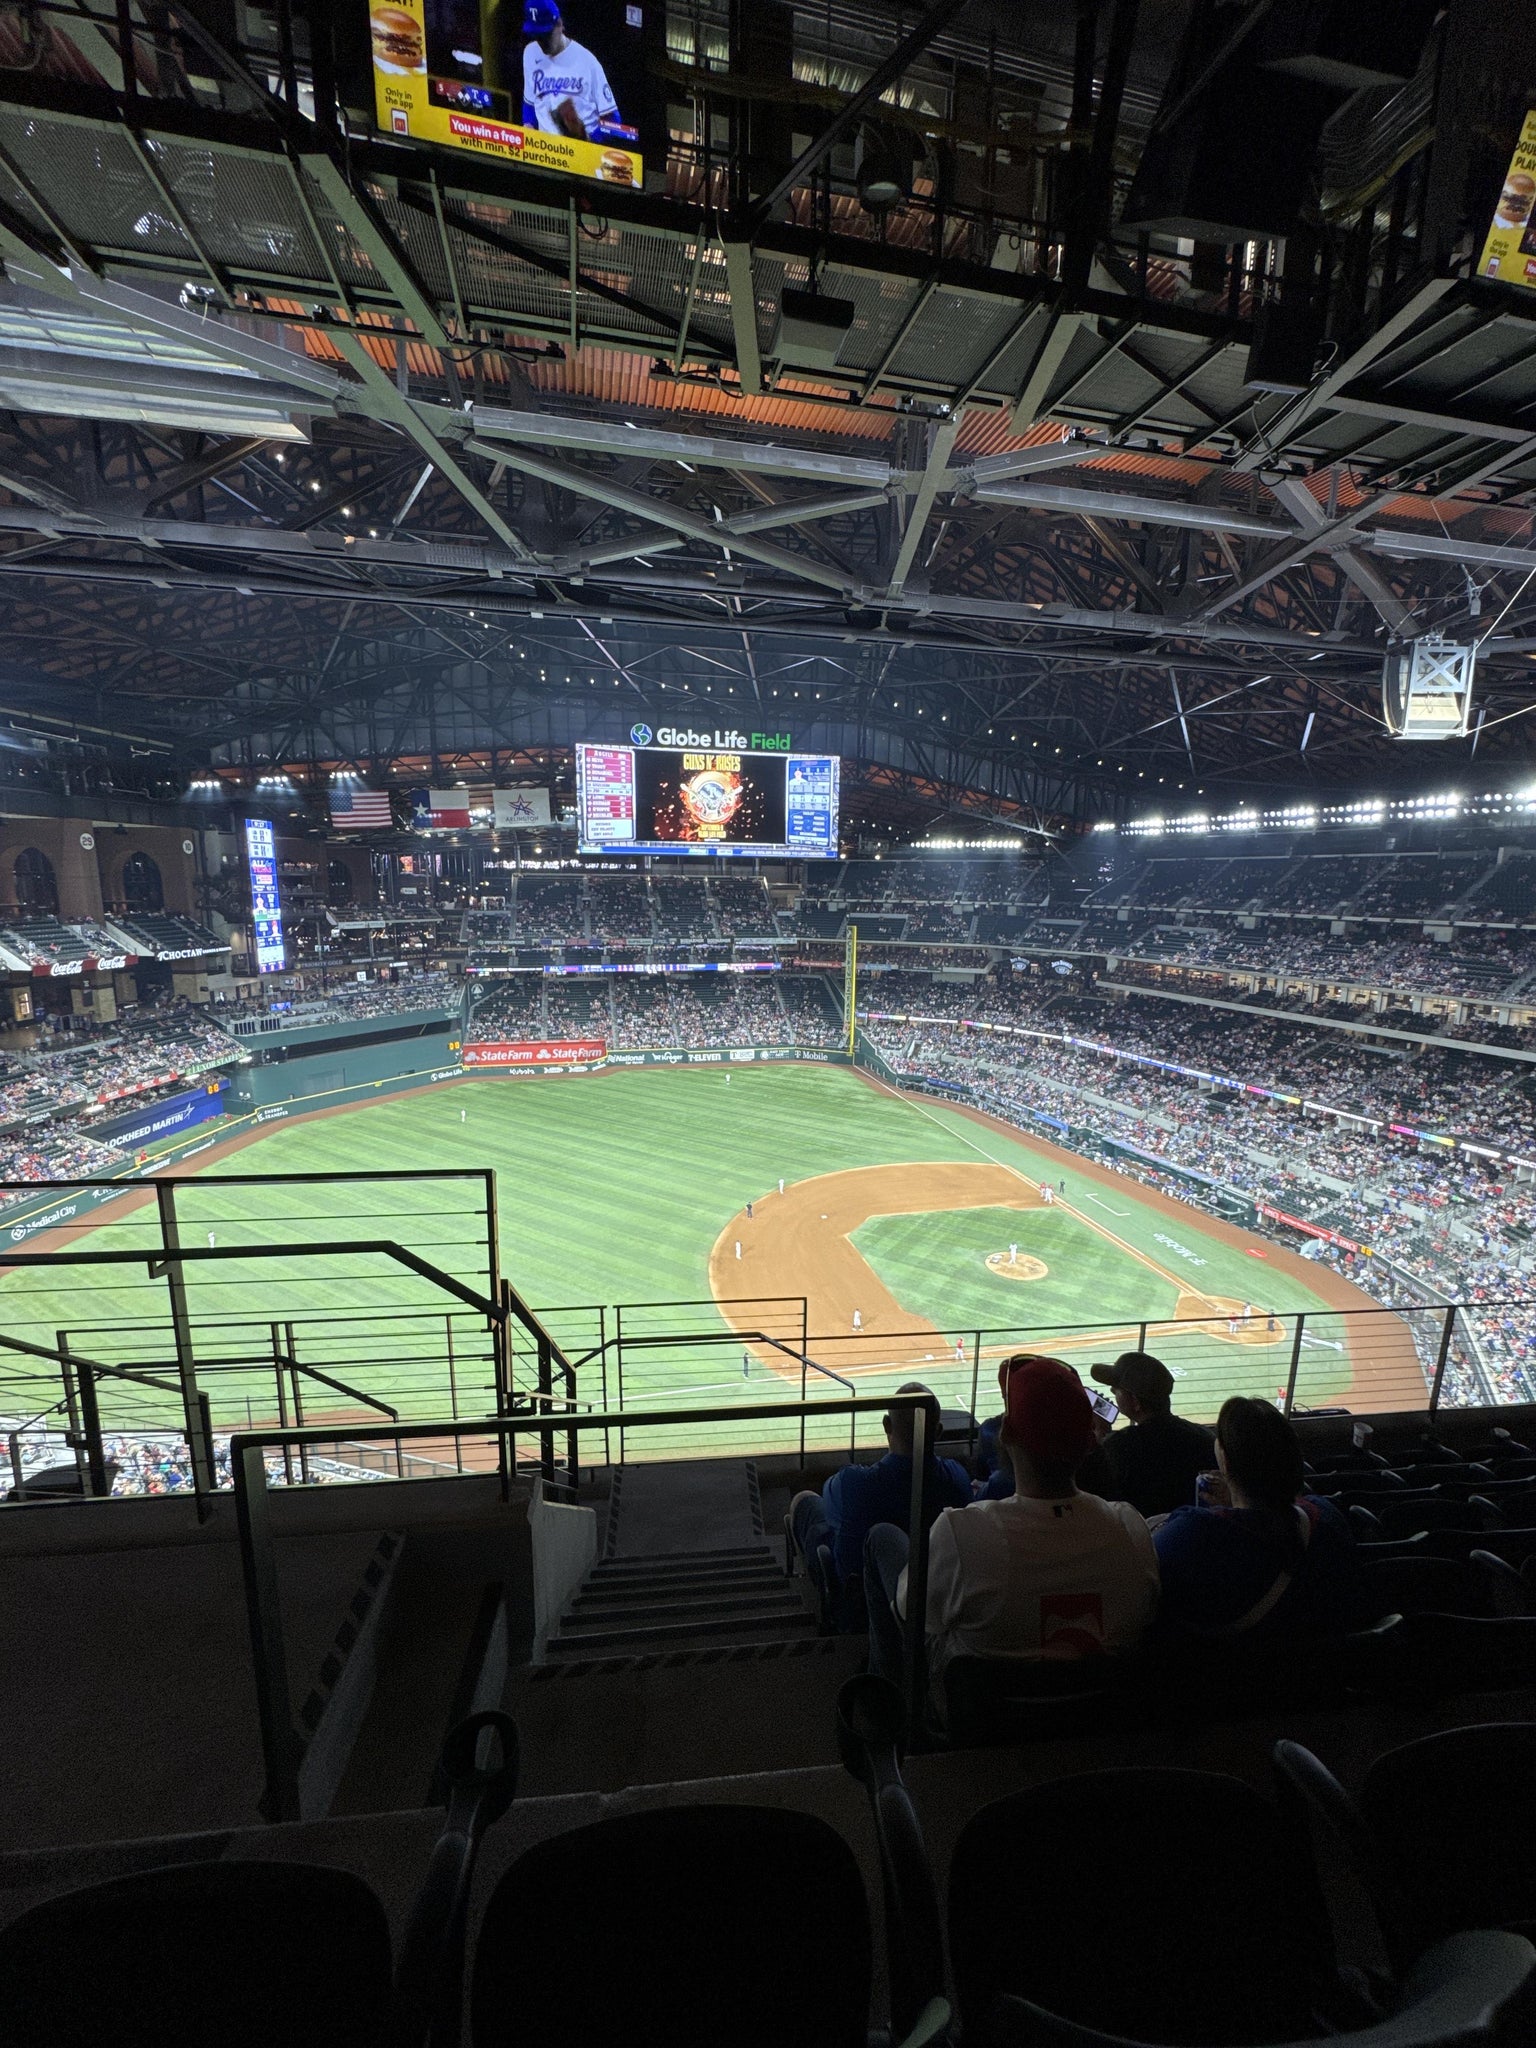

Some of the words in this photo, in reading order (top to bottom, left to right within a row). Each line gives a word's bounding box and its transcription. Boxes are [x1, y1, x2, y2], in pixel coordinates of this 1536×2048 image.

[532, 69, 584, 95] Rangers
[385, 87, 403, 100] Only
[404, 92, 412, 100] in
[385, 96, 398, 105] the
[399, 99, 413, 109] app
[451, 119, 471, 133] You
[472, 125, 492, 137] win
[500, 129, 522, 145] free
[460, 136, 483, 149] with
[485, 141, 507, 154] min.
[509, 145, 520, 157] $2
[522, 150, 570, 168] purchase.
[525, 136, 575, 157] McDouble
[656, 728, 712, 747] Globe
[714, 730, 748, 749] Life
[751, 732, 791, 750] Field
[683, 754, 706, 770] GUNS
[716, 755, 741, 772] ROSES
[163, 948, 203, 960] CHOCTAW
[661, 1052, 683, 1064] Kroger
[802, 1050, 829, 1061] Mobile
[192, 1060, 216, 1074] LUXOR
[26, 1112, 52, 1124] ARENA
[105, 1126, 151, 1148] LOCKHEED
[152, 1113, 184, 1132] MARTIN
[27, 1207, 60, 1233] Medical
[60, 1204, 77, 1222] City
